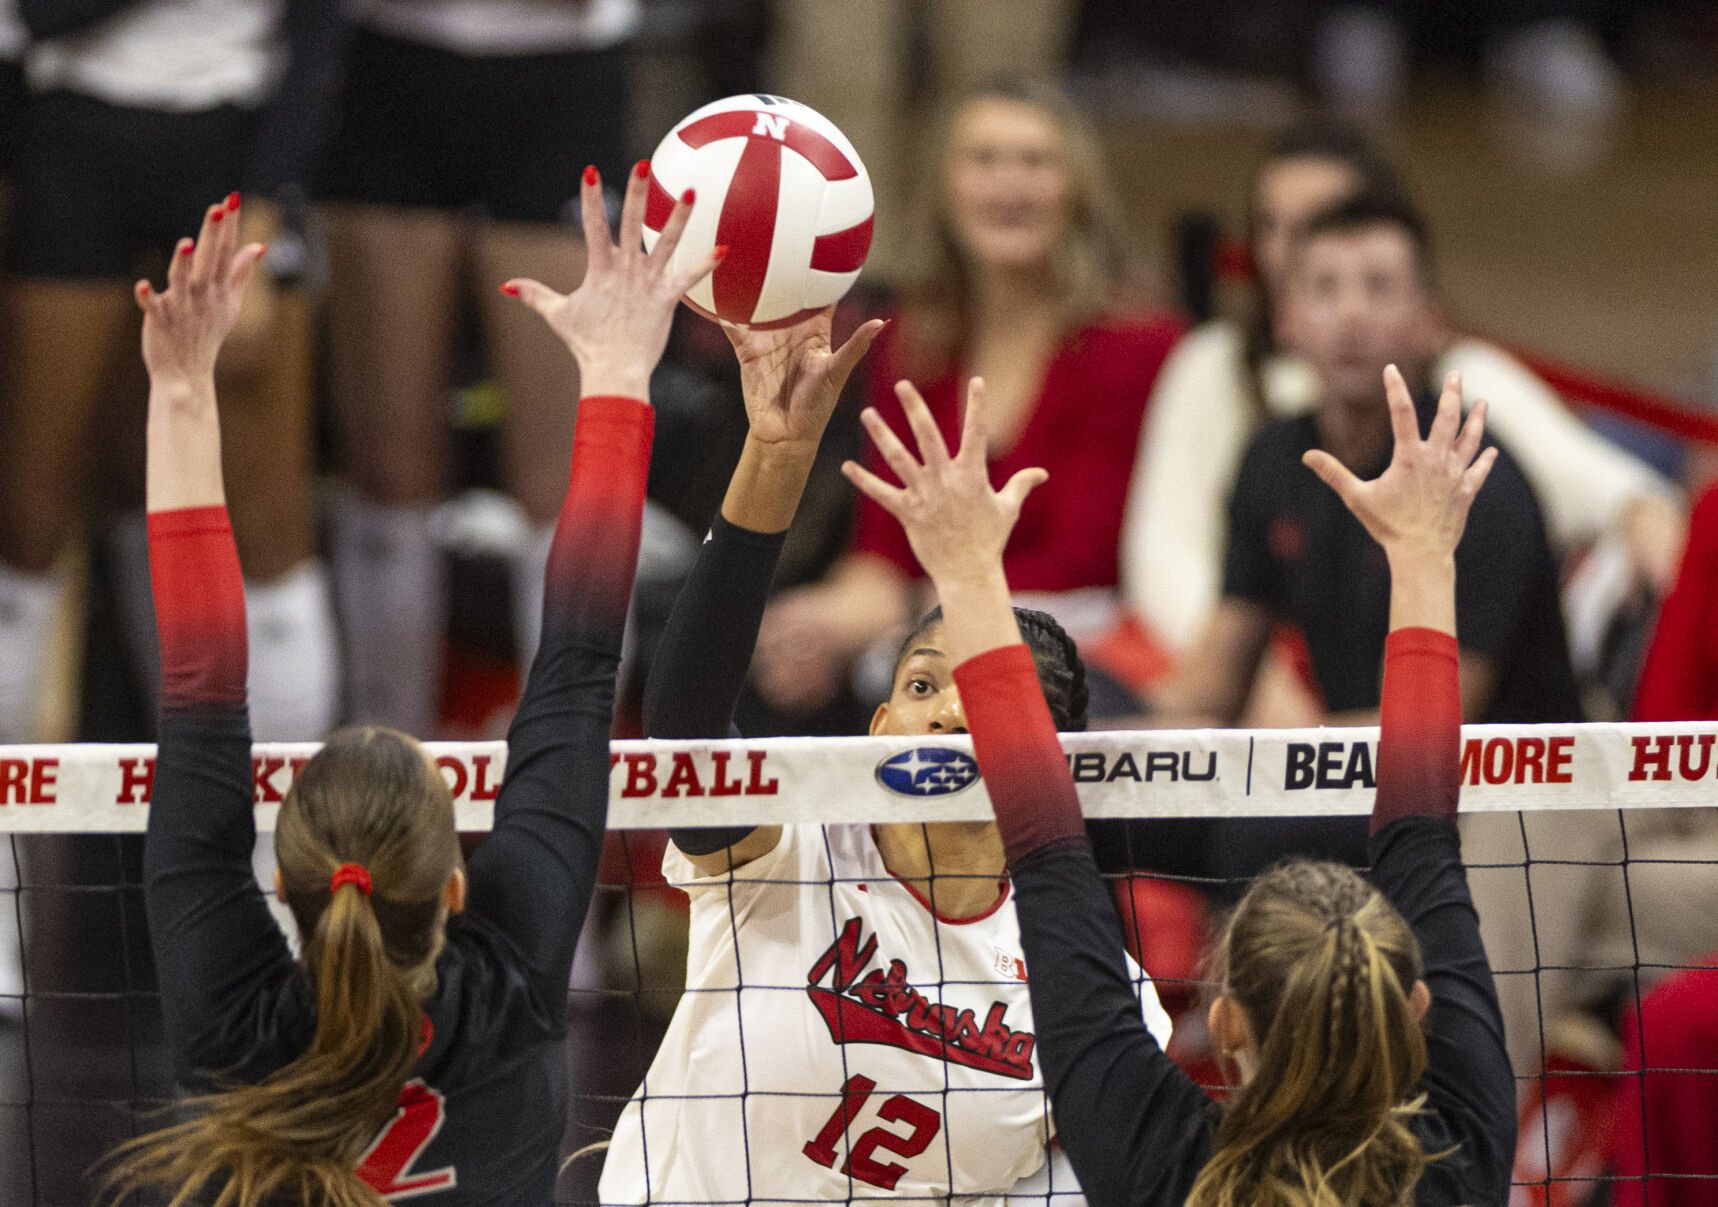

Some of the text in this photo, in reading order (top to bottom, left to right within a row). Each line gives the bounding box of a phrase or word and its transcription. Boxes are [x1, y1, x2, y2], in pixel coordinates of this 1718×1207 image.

[752, 112, 790, 141] N
[1065, 751, 1217, 783] BARU
[1628, 734, 1718, 782] HU
[807, 916, 1036, 1067] Nebraska
[802, 1073, 941, 1191] 12
